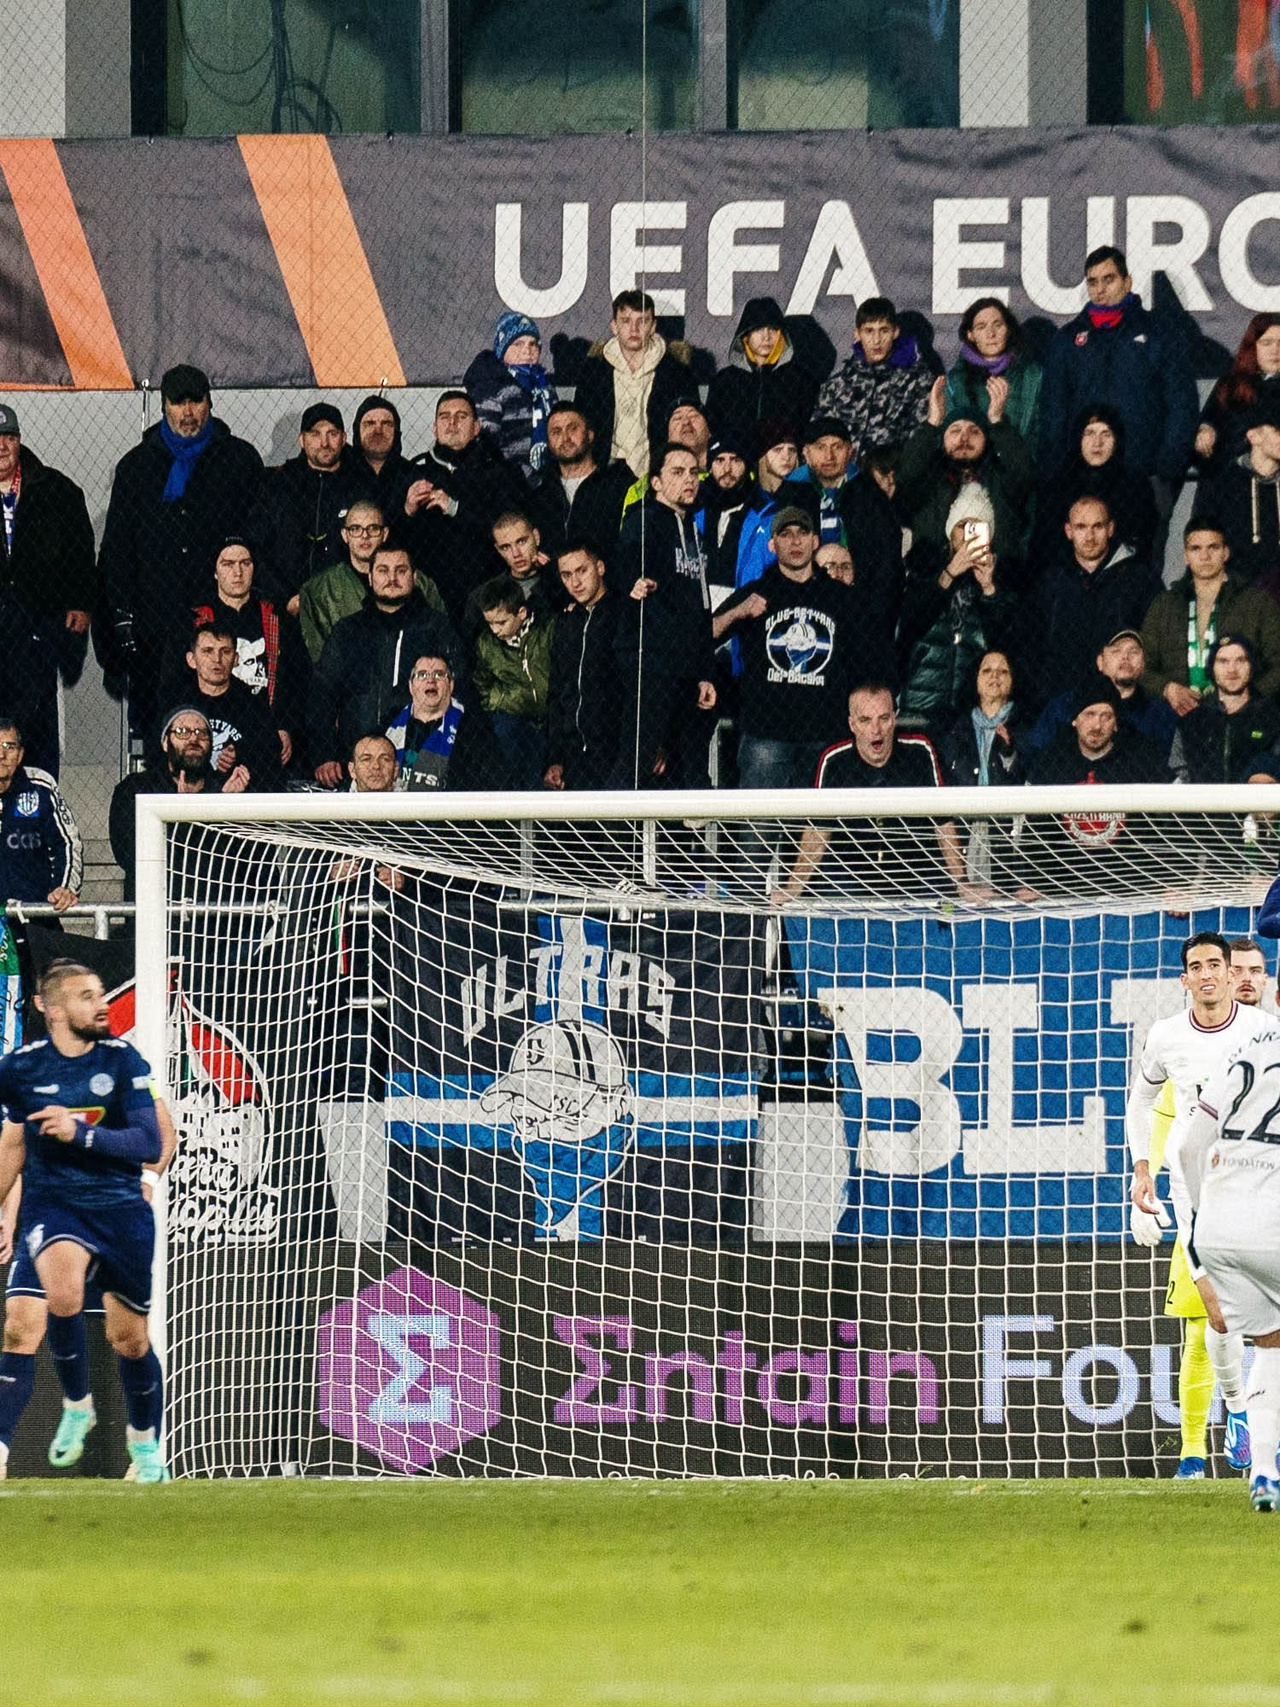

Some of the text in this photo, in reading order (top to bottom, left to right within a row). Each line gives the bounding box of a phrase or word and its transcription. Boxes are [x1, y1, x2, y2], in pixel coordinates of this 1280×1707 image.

[494, 199, 882, 318] UEFA
[208, 719, 242, 742] ETYARS
[461, 944, 677, 1047] ULTRAS
